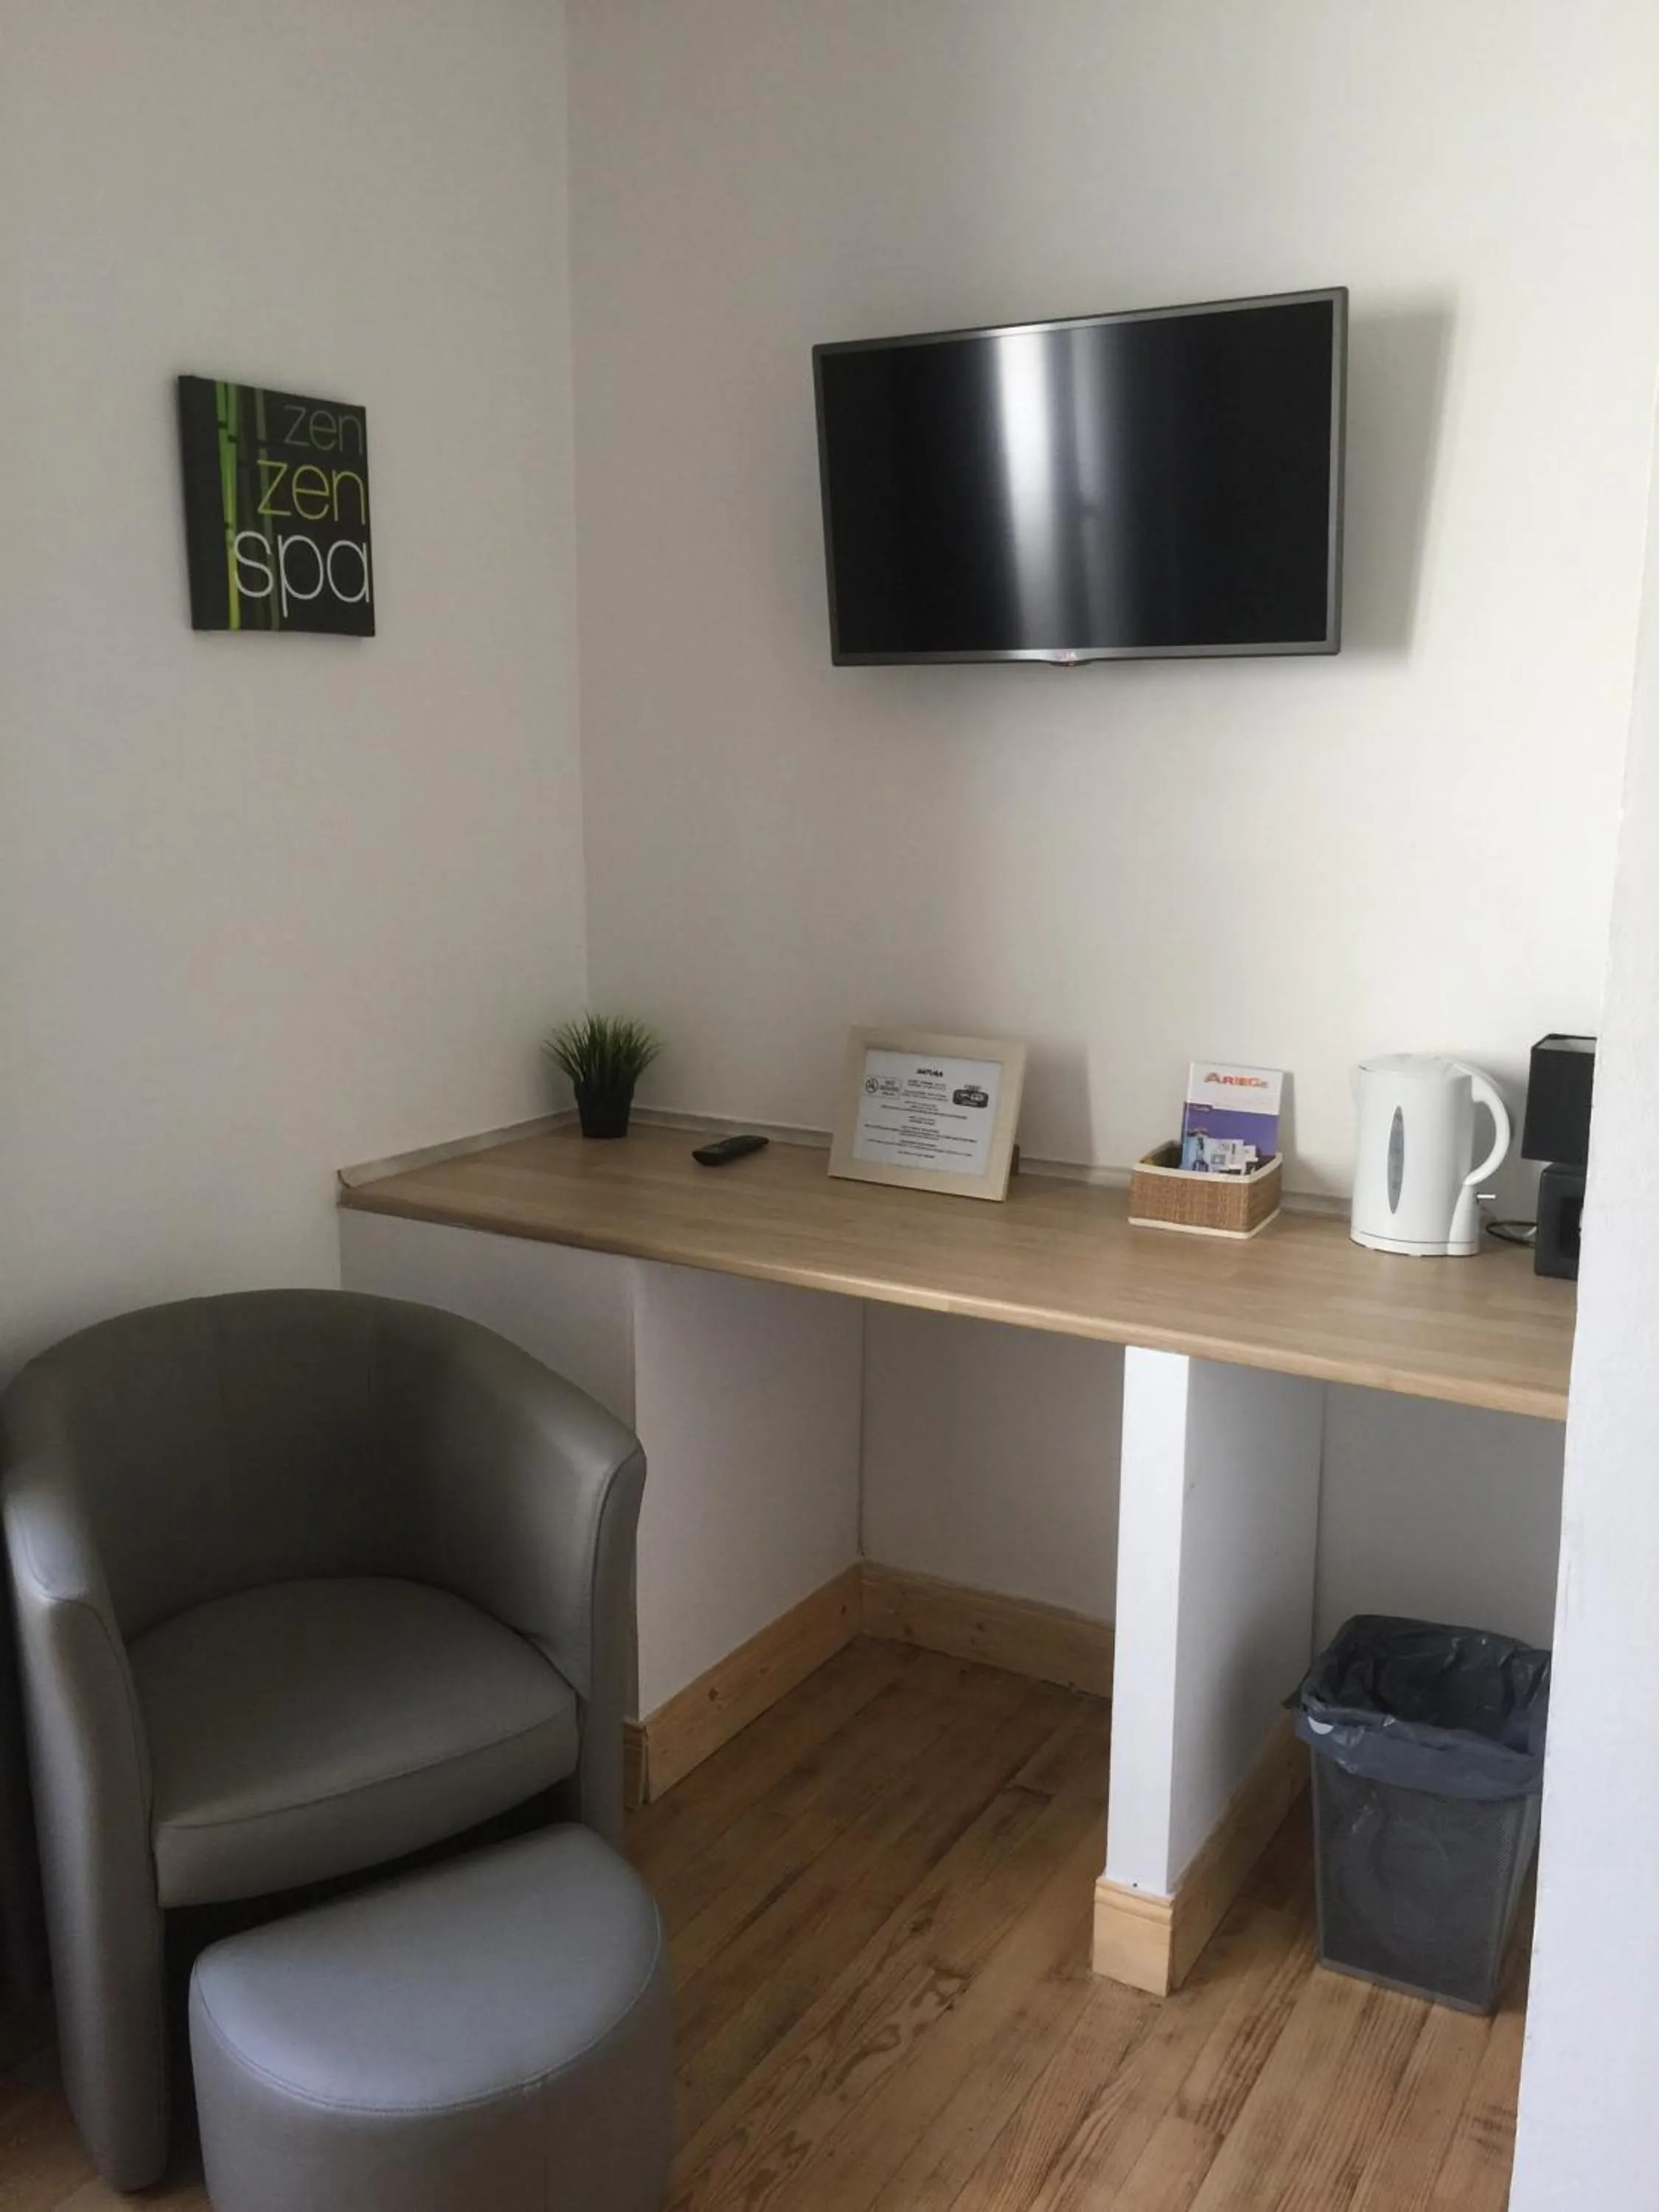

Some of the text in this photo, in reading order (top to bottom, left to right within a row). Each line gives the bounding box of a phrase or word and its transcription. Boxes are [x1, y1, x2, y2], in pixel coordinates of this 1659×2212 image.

[284, 405, 363, 454] zen
[257, 459, 366, 526] zen
[234, 529, 370, 619] spa
